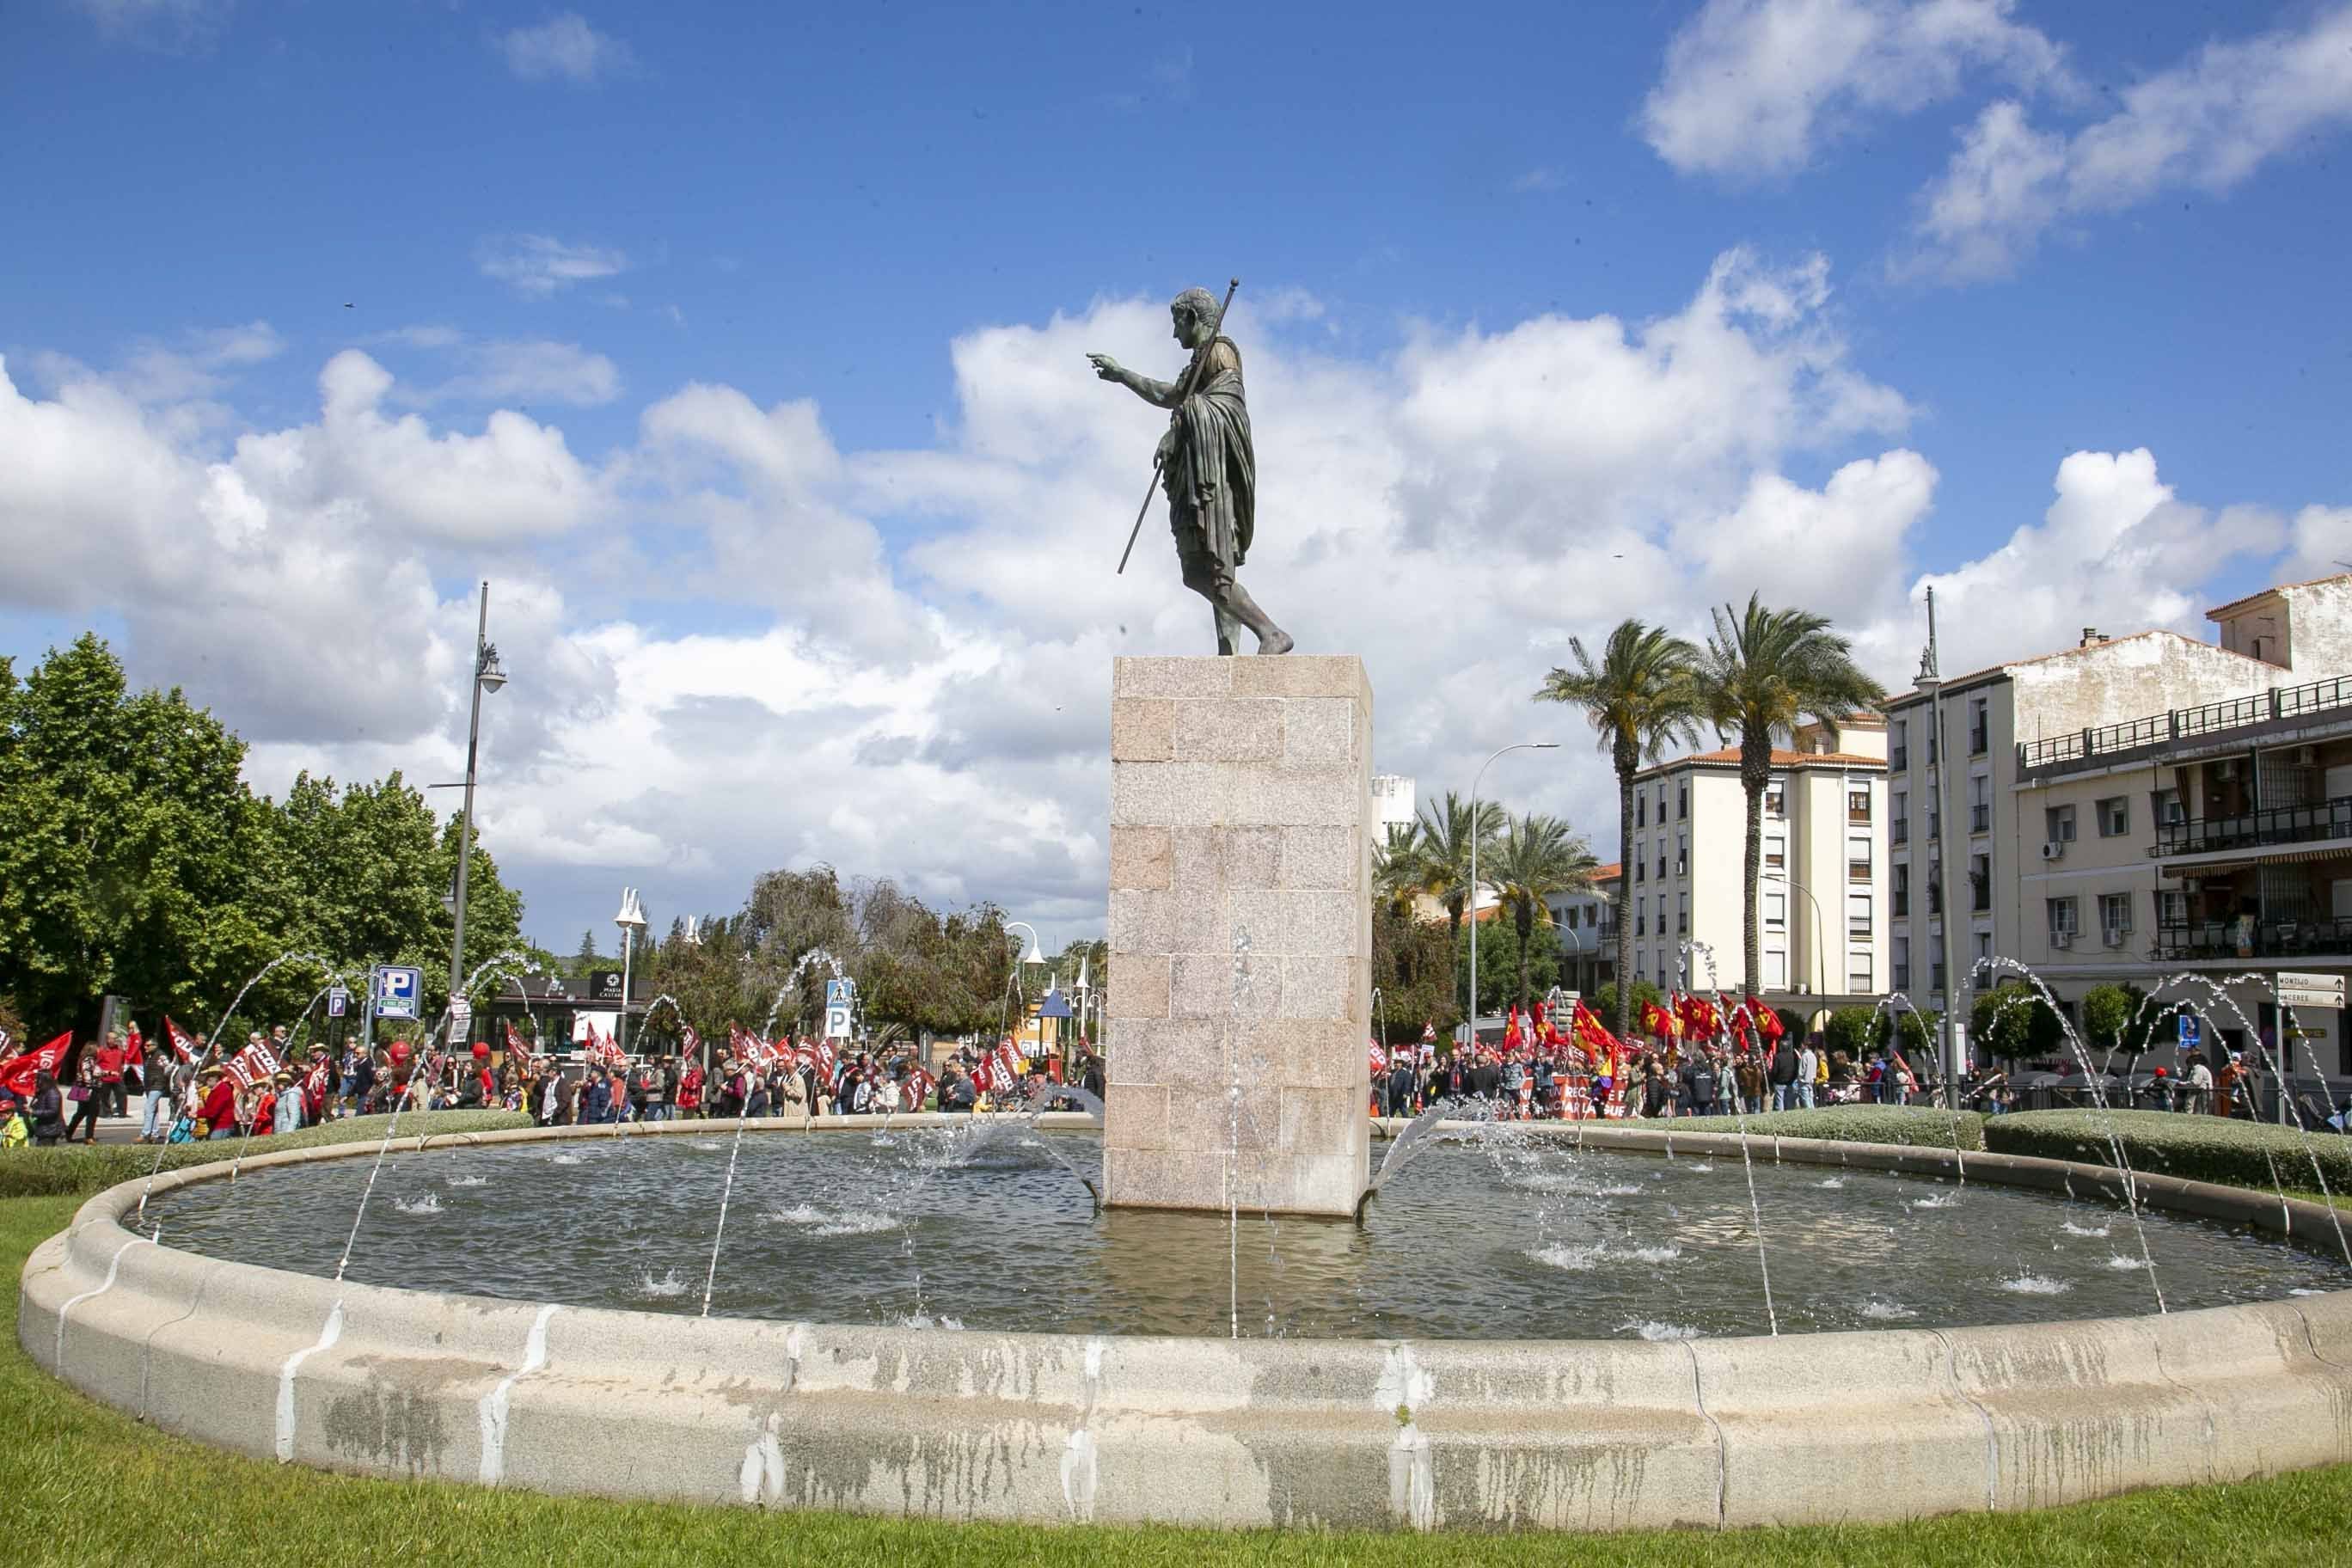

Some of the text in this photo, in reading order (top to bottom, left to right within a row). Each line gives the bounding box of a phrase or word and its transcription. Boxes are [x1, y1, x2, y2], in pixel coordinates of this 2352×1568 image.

[386, 972, 410, 995] P
[333, 998, 342, 1013] P
[830, 1011, 845, 1033] P
